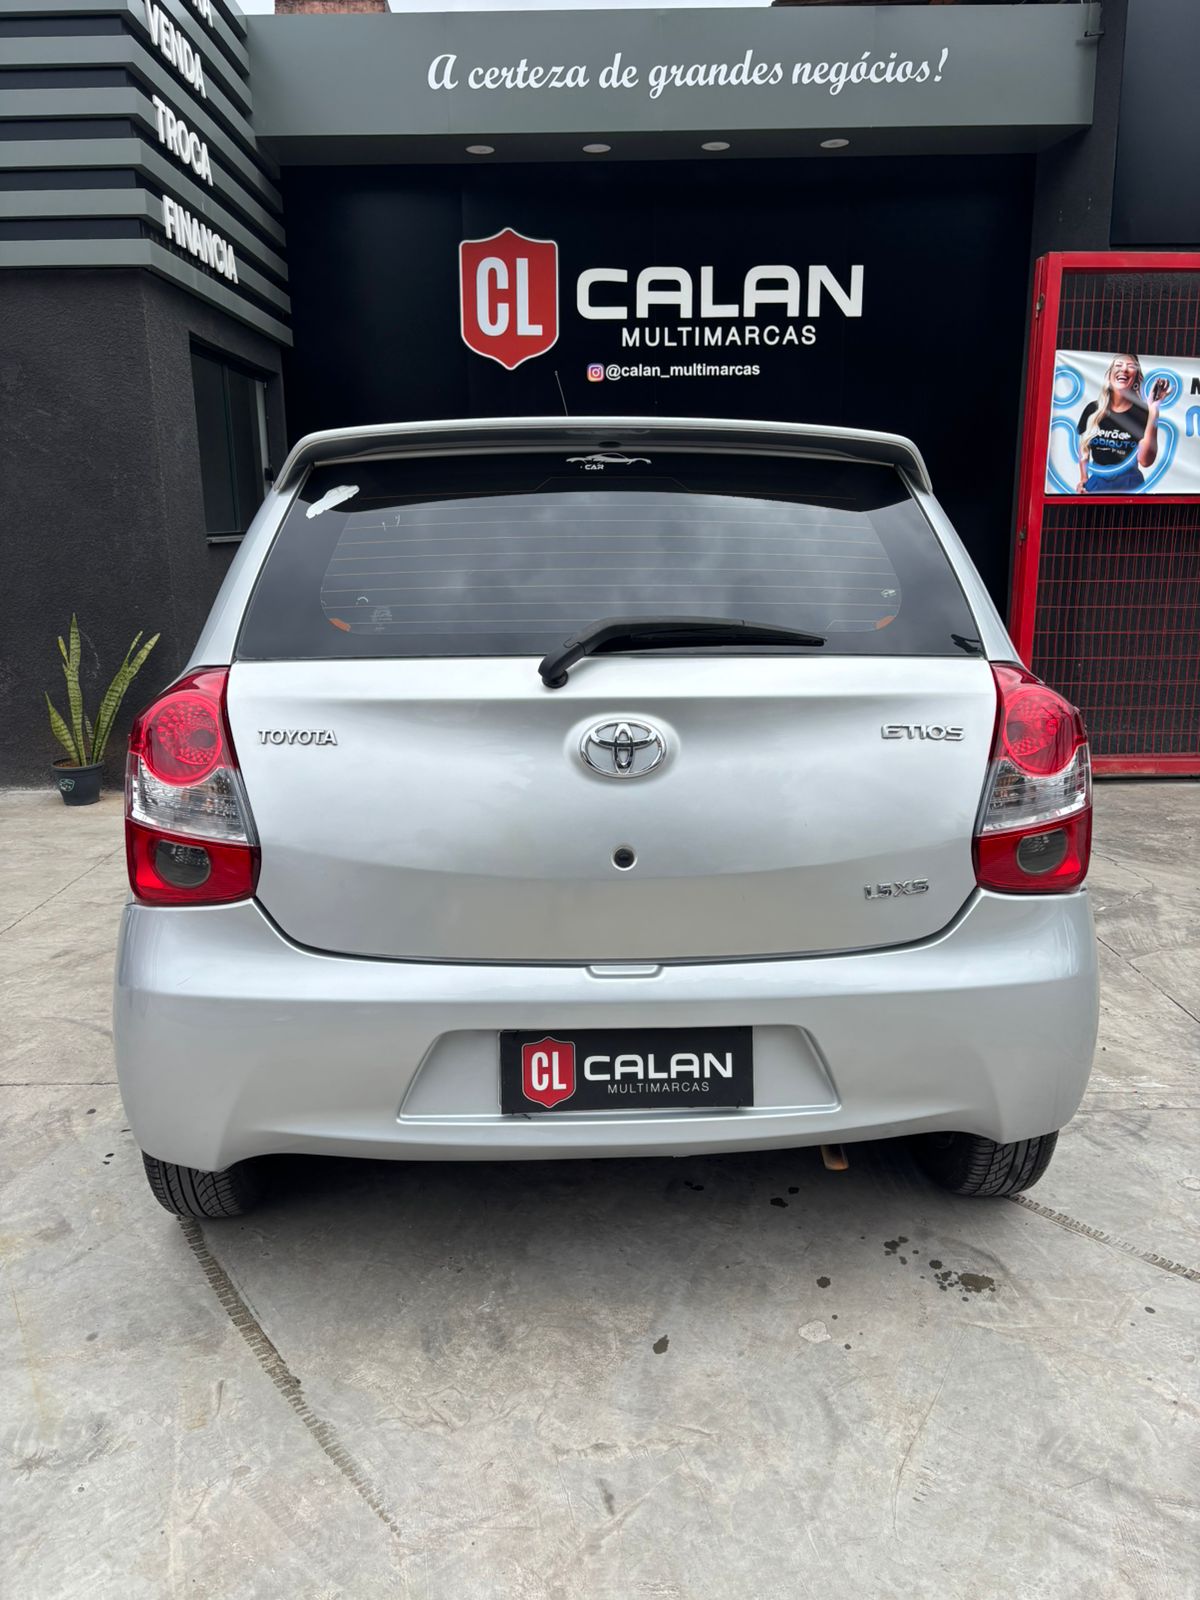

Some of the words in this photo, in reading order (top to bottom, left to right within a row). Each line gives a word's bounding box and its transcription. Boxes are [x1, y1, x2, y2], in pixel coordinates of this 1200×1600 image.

[144, 0, 207, 98] VENDA
[428, 54, 460, 90] A
[468, 57, 590, 89] certeza
[599, 52, 638, 89] de
[648, 49, 784, 98] grandes
[792, 47, 949, 96] negócios!
[152, 95, 213, 186] TROCA
[162, 195, 238, 284] FINANCIA
[476, 256, 543, 337] CL
[576, 264, 865, 319] CALAN
[621, 325, 817, 347] MULTIMARCAS
[605, 363, 760, 380] @calan_multimarcas
[258, 729, 338, 746] TOYOTA
[881, 723, 965, 741] ETIOS
[531, 1052, 567, 1092] CL
[584, 1052, 733, 1082] CALAN
[607, 1081, 711, 1095] MULTIMARCAS
